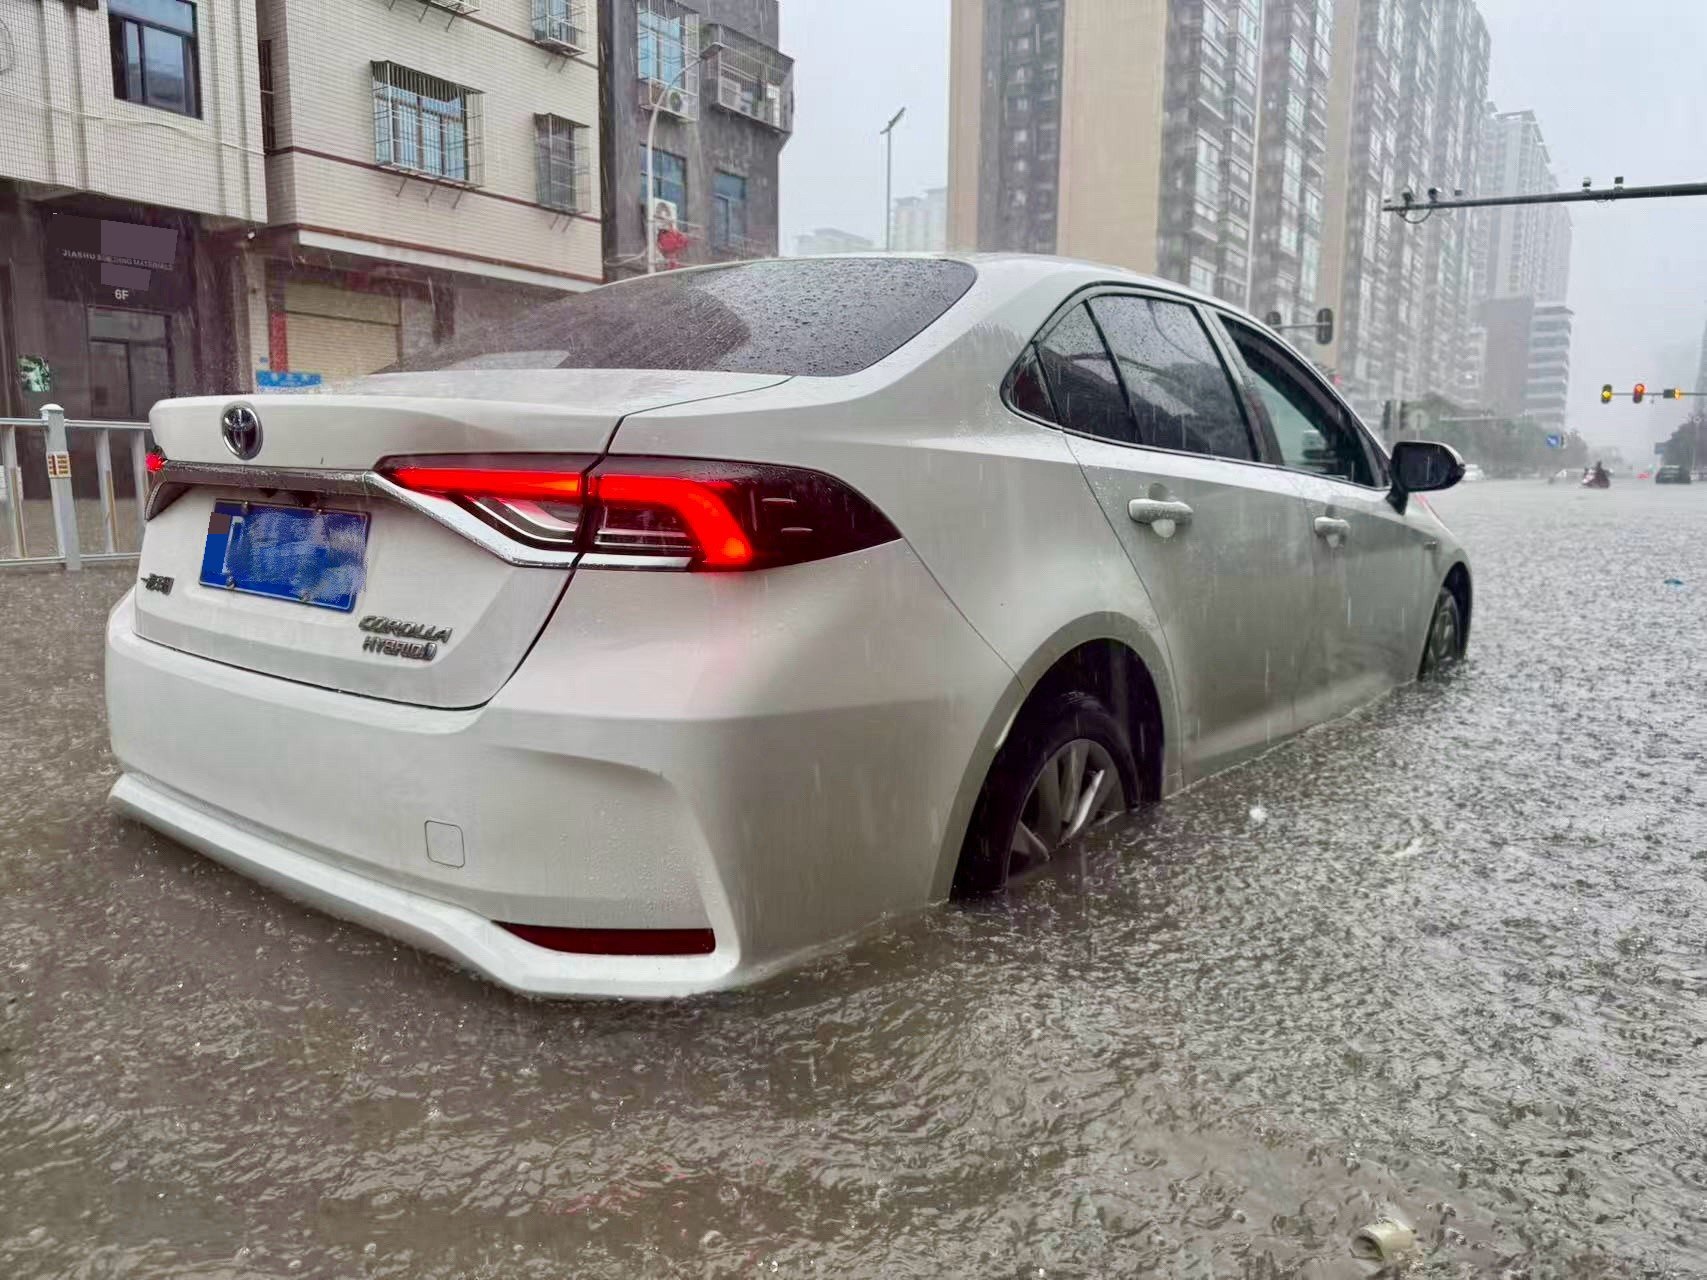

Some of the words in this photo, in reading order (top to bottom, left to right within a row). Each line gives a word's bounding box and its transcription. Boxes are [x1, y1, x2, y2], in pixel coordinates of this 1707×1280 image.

[114, 288, 129, 300] 6F
[358, 614, 453, 643] COROLLA
[362, 635, 425, 660] HYBRID
